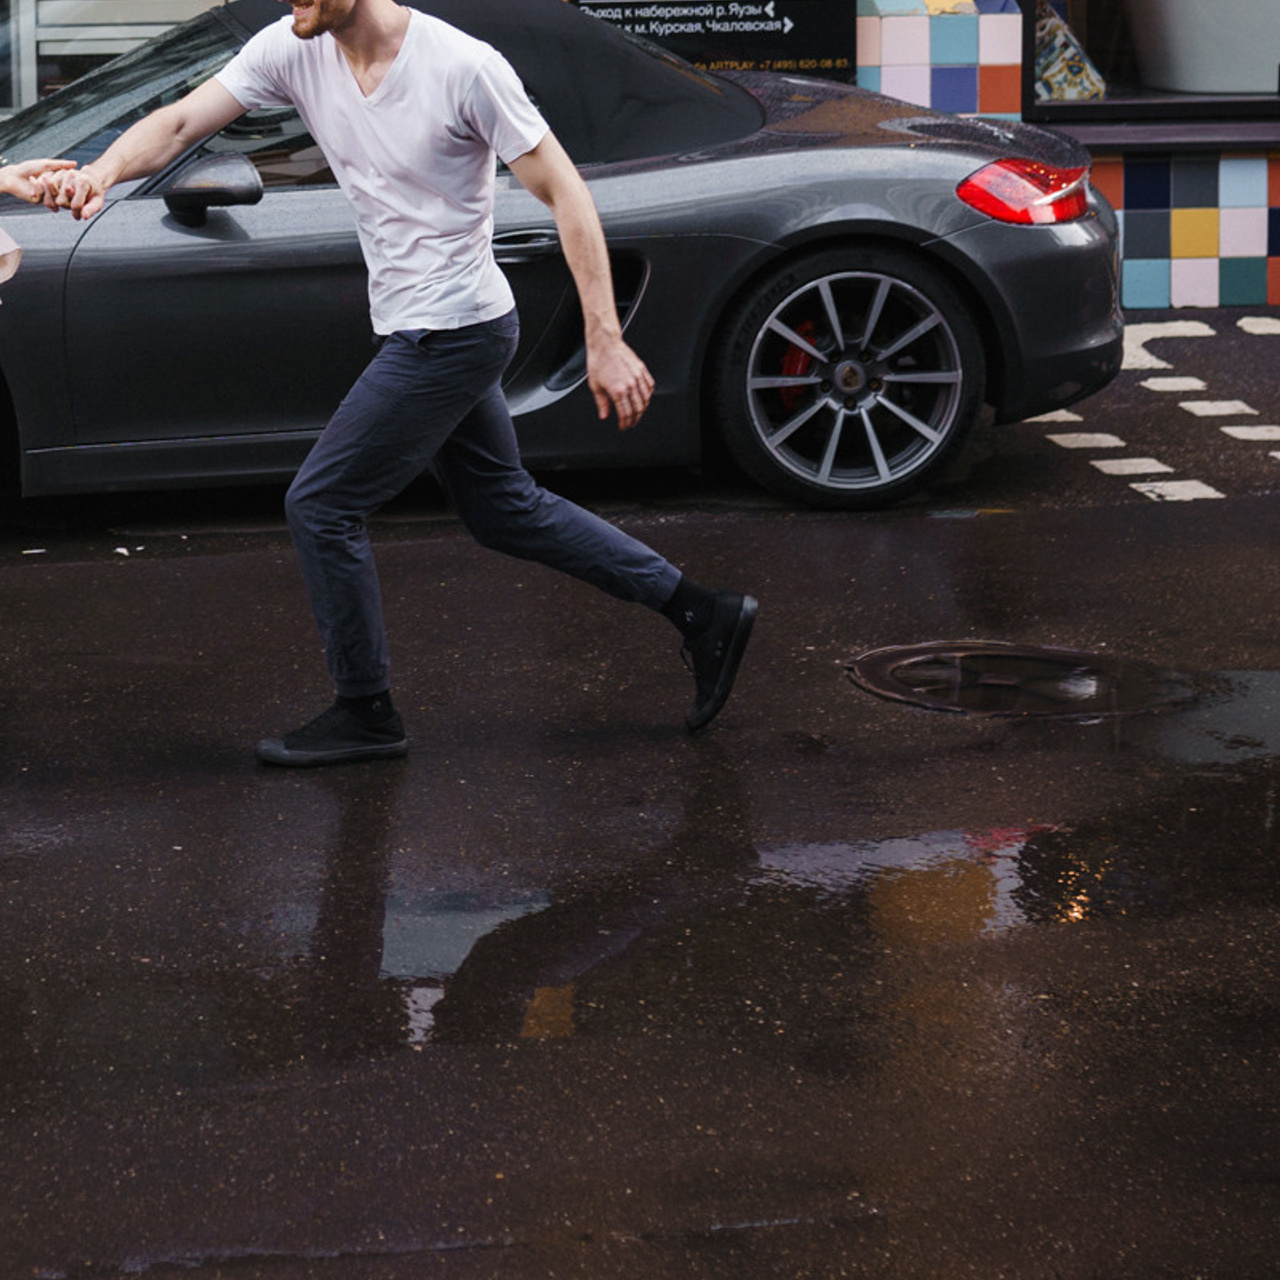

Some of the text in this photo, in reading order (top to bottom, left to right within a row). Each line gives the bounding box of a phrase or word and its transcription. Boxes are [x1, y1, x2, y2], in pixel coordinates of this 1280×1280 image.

[624, 8, 633, 17] к
[634, 4, 715, 19] набережной
[728, 3, 763, 18] Яузы
[649, 21, 705, 36] Курская,
[705, 20, 782, 32] Чкаловская
